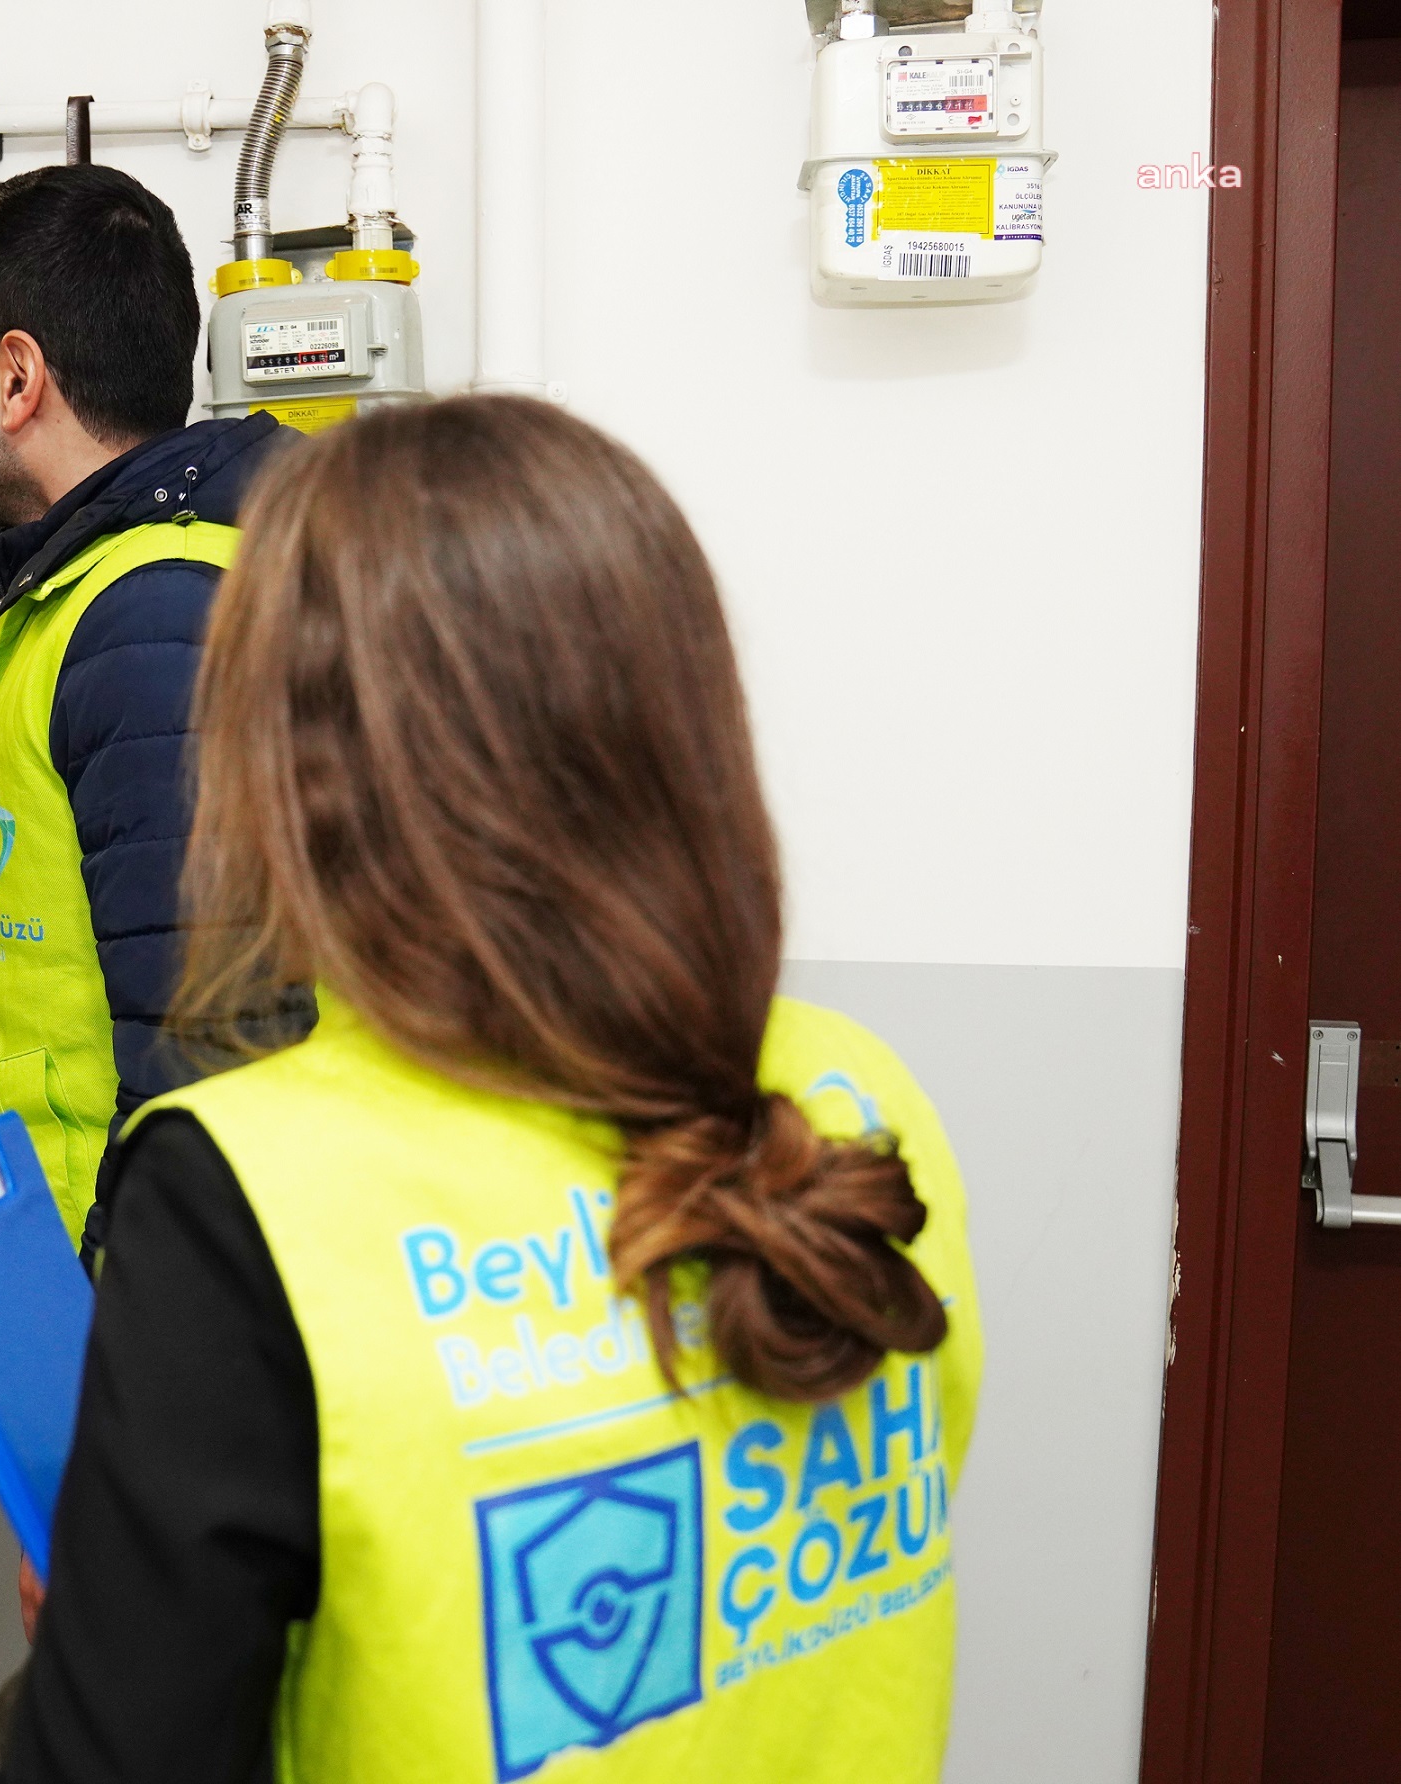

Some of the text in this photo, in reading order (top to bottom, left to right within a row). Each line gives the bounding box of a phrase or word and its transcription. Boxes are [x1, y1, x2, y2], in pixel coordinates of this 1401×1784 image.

[907, 241, 965, 251] 19425680015
[305, 364, 336, 373] AMCO
[722, 1362, 939, 1535] SAH
